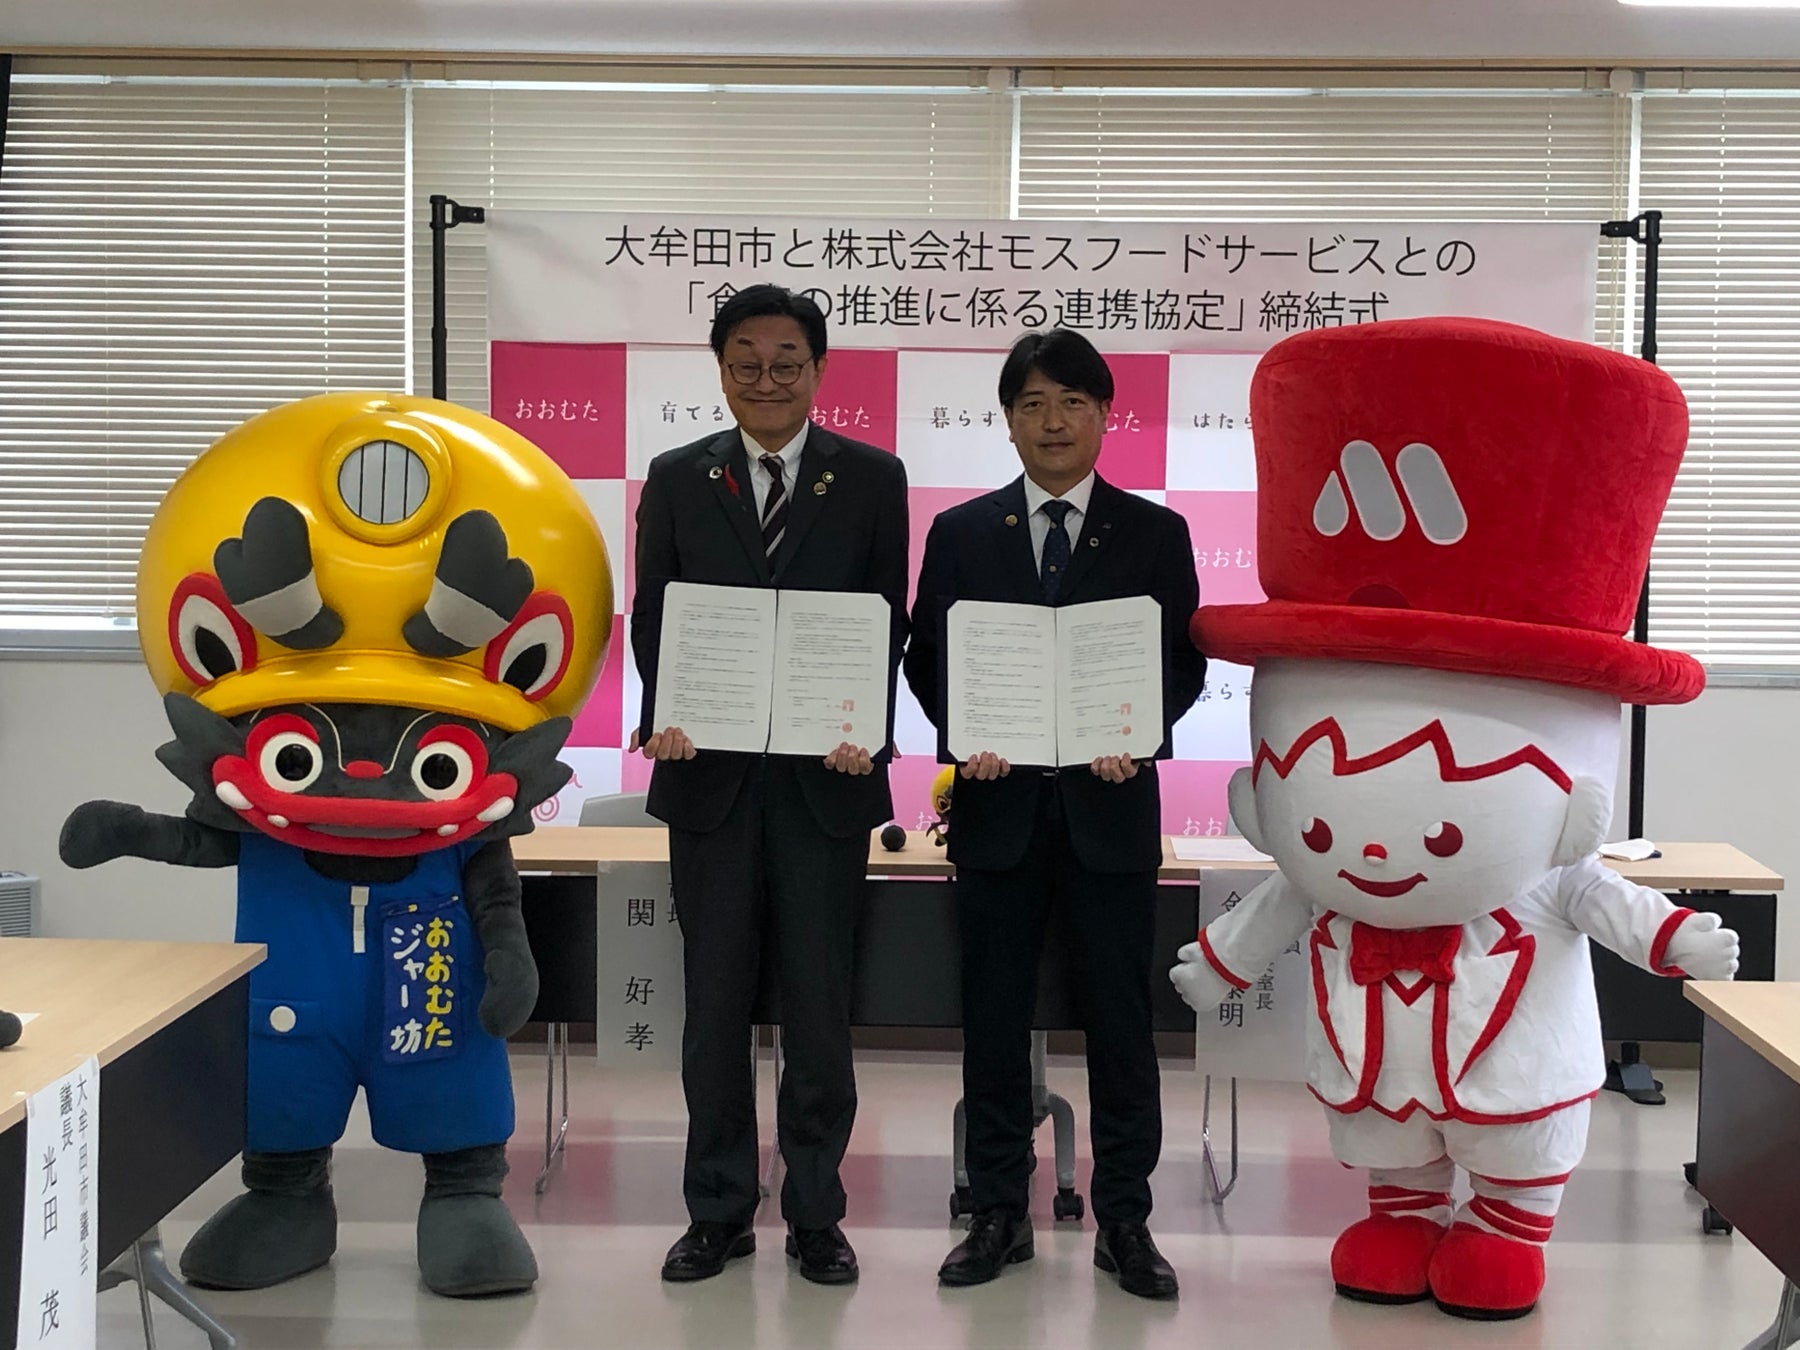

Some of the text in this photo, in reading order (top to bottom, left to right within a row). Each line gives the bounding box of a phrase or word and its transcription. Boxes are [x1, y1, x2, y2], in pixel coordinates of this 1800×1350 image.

[604, 225, 1476, 277] 大牟田市と株式会社モスフードサービスとの
[688, 280, 1390, 333] 「食の推進に係る連携協定」締結式
[515, 398, 599, 421] おおむた
[660, 401, 724, 424] 育てる
[931, 406, 997, 429] 暮らす
[391, 923, 425, 1054] ジャー坊
[425, 917, 454, 1049] おおむた
